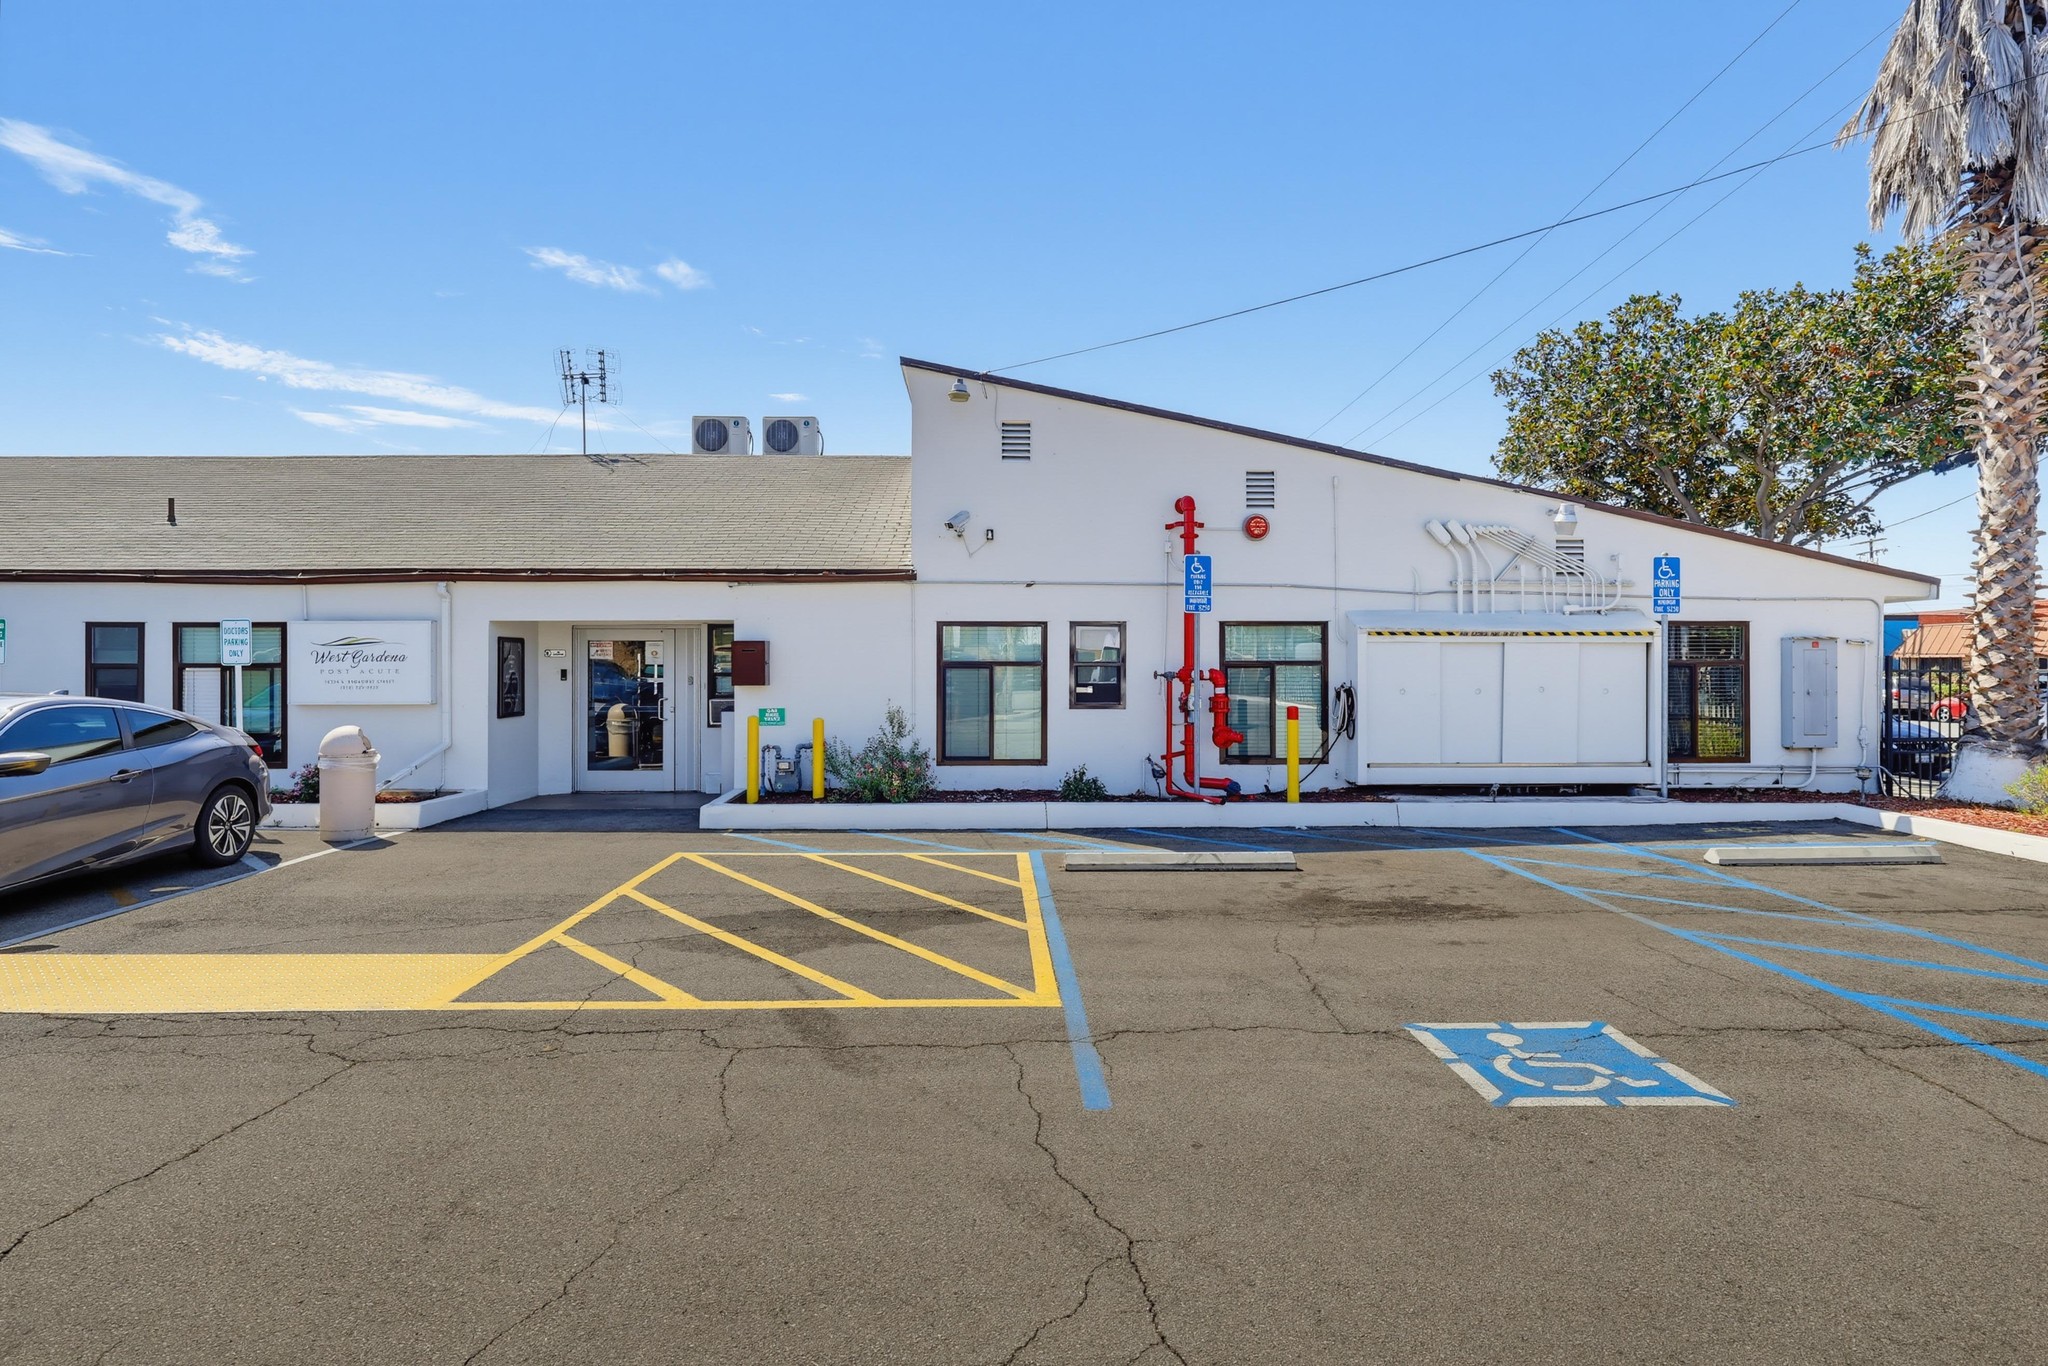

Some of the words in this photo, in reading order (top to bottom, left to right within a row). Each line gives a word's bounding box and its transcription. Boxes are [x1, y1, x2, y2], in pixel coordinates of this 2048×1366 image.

[1654, 579, 1680, 588] PARKING
[1659, 588, 1675, 597] ONLY
[223, 627, 249, 635] DOCTORS
[223, 638, 249, 646] PARKING
[228, 649, 244, 657] ONLY
[310, 650, 352, 665] West
[350, 650, 408, 669] Gardena
